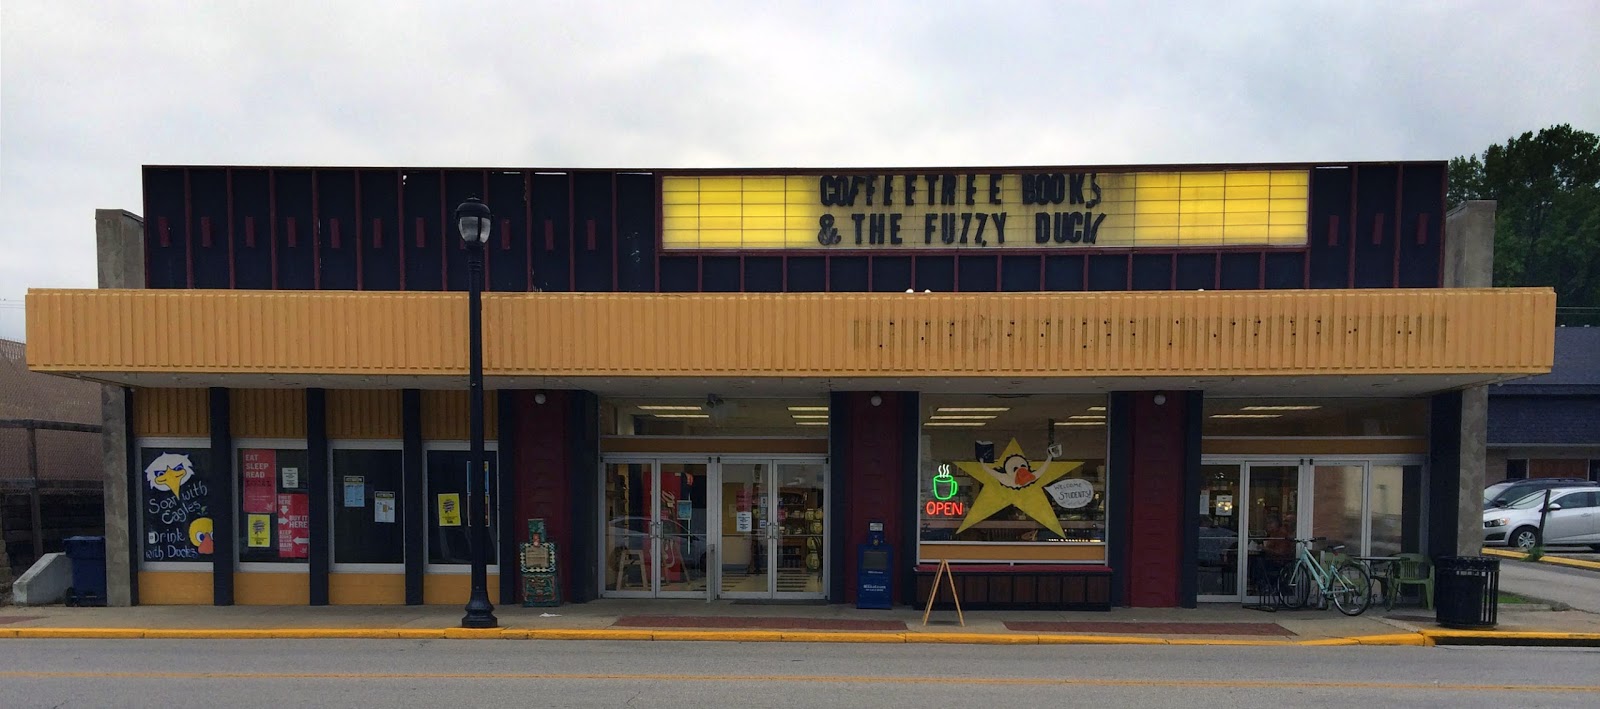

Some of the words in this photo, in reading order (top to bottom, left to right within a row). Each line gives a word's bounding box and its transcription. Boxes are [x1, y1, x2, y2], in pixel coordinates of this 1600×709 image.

[819, 174, 1002, 206] COFFEETREE
[1022, 173, 1102, 208] BOOKS
[818, 214, 841, 245] &
[852, 213, 903, 244] THE
[925, 212, 1007, 247] FUZZY
[1035, 212, 1106, 244] DUCK
[1053, 482, 1082, 490] WELCOME
[149, 495, 177, 514] Soar
[182, 480, 208, 500] with
[161, 500, 201, 524] Eagles
[926, 501, 963, 516] OPEN
[149, 528, 186, 543] Drink
[145, 545, 164, 560] with
